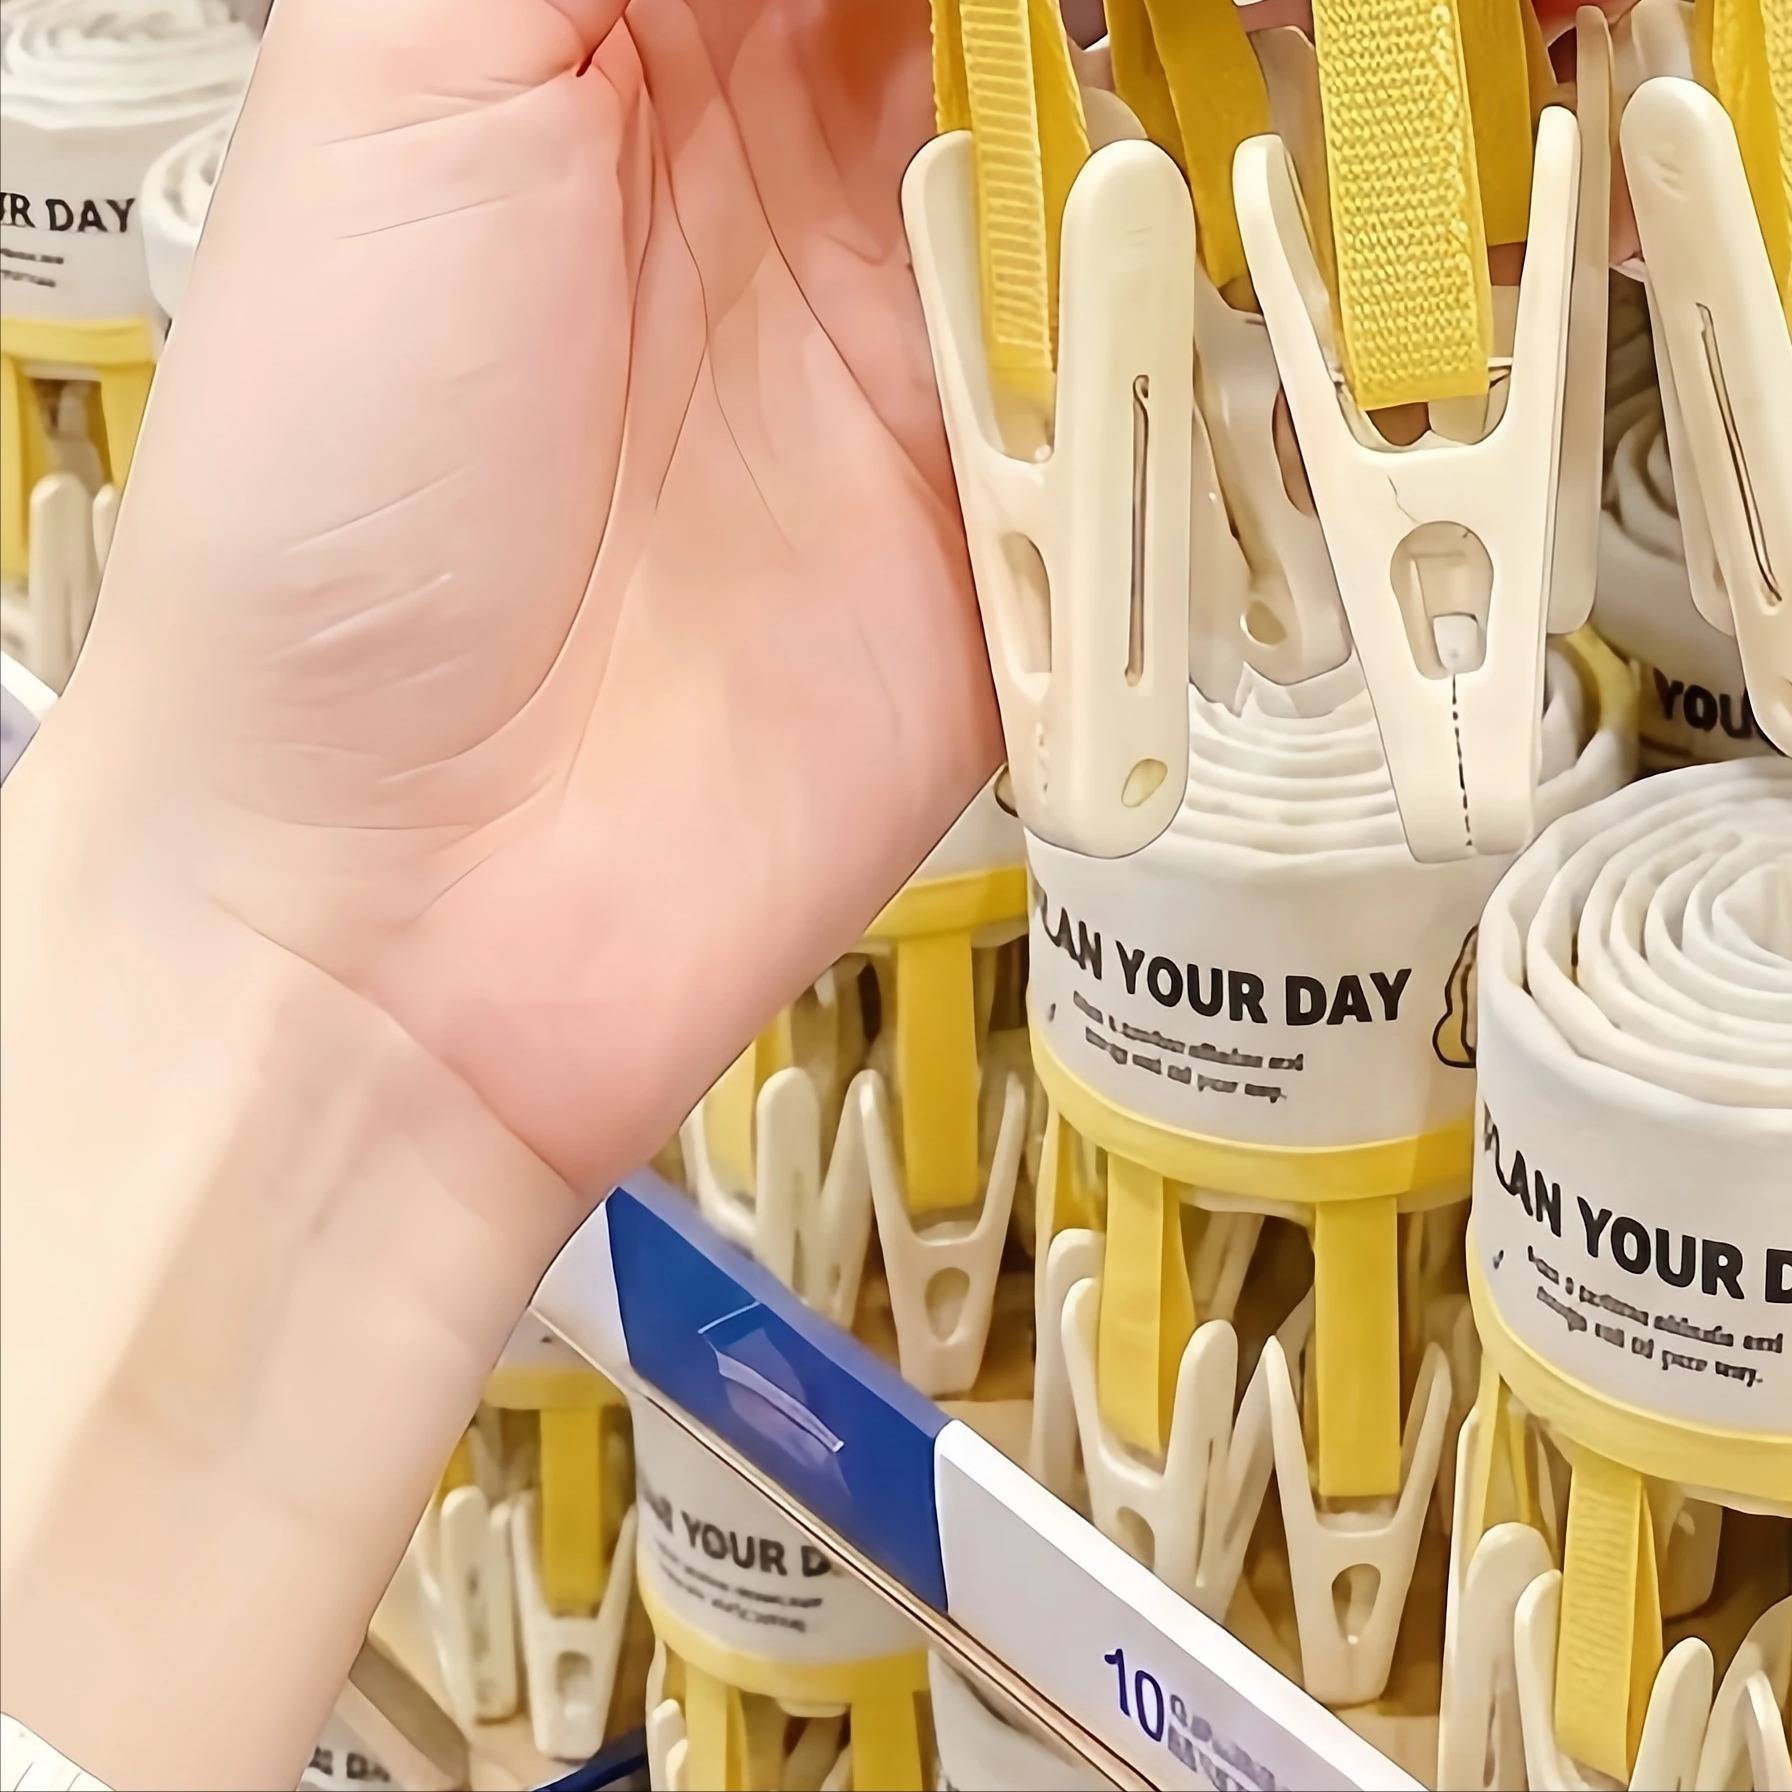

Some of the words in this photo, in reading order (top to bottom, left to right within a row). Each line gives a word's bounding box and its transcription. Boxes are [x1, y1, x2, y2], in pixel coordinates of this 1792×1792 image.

[45, 197, 136, 233] DAY
[1115, 940, 1268, 1024] YOUR
[1285, 968, 1412, 1026] DAY
[1576, 1195, 1745, 1300] YOUR
[681, 1510, 788, 1577] YOUR
[1104, 1648, 1165, 1742] 10
